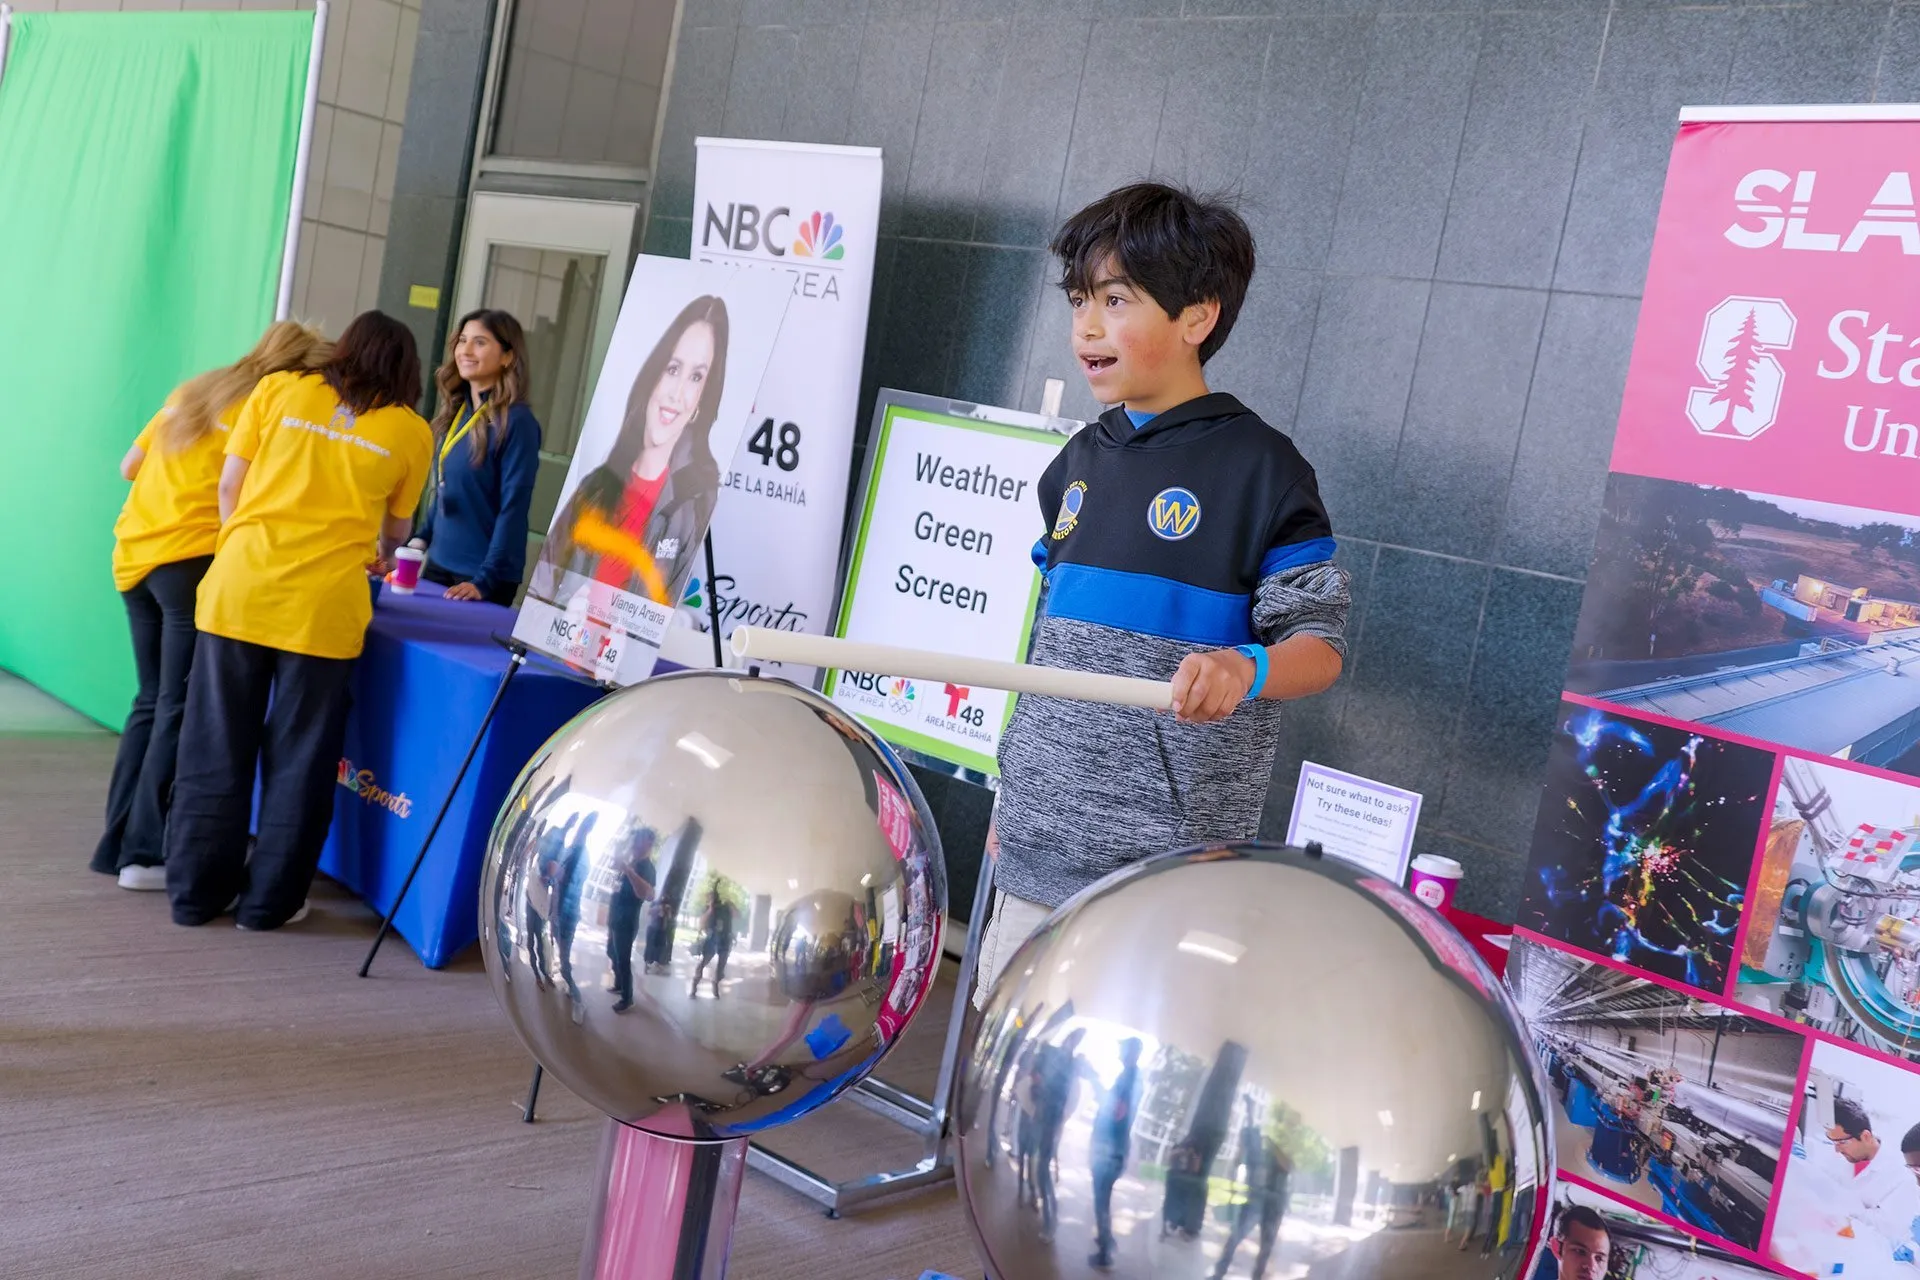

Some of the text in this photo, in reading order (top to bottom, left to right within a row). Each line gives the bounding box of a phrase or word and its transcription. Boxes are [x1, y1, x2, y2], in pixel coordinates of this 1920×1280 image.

[702, 202, 790, 257] NBC
[747, 417, 801, 472] 48
[745, 475, 762, 495] LA
[766, 481, 806, 507] BAHÍA
[915, 452, 1028, 503] Weather
[1155, 496, 1198, 535] W
[914, 511, 993, 556] Green
[705, 574, 808, 632] Sports
[895, 564, 988, 614] Screen
[611, 592, 639, 618] Vianey
[639, 604, 666, 625] Arana
[550, 617, 577, 641] NBC
[604, 647, 618, 663] 48
[838, 688, 885, 709] BAY AREA
[842, 670, 891, 696] NBC
[945, 720, 957, 731] DE
[957, 724, 968, 735] LA
[960, 705, 985, 727] 48
[356, 768, 413, 819] Sports
[1307, 778, 1410, 815] Not sure what to ask?
[1317, 797, 1333, 812] Try
[1334, 803, 1361, 818] these
